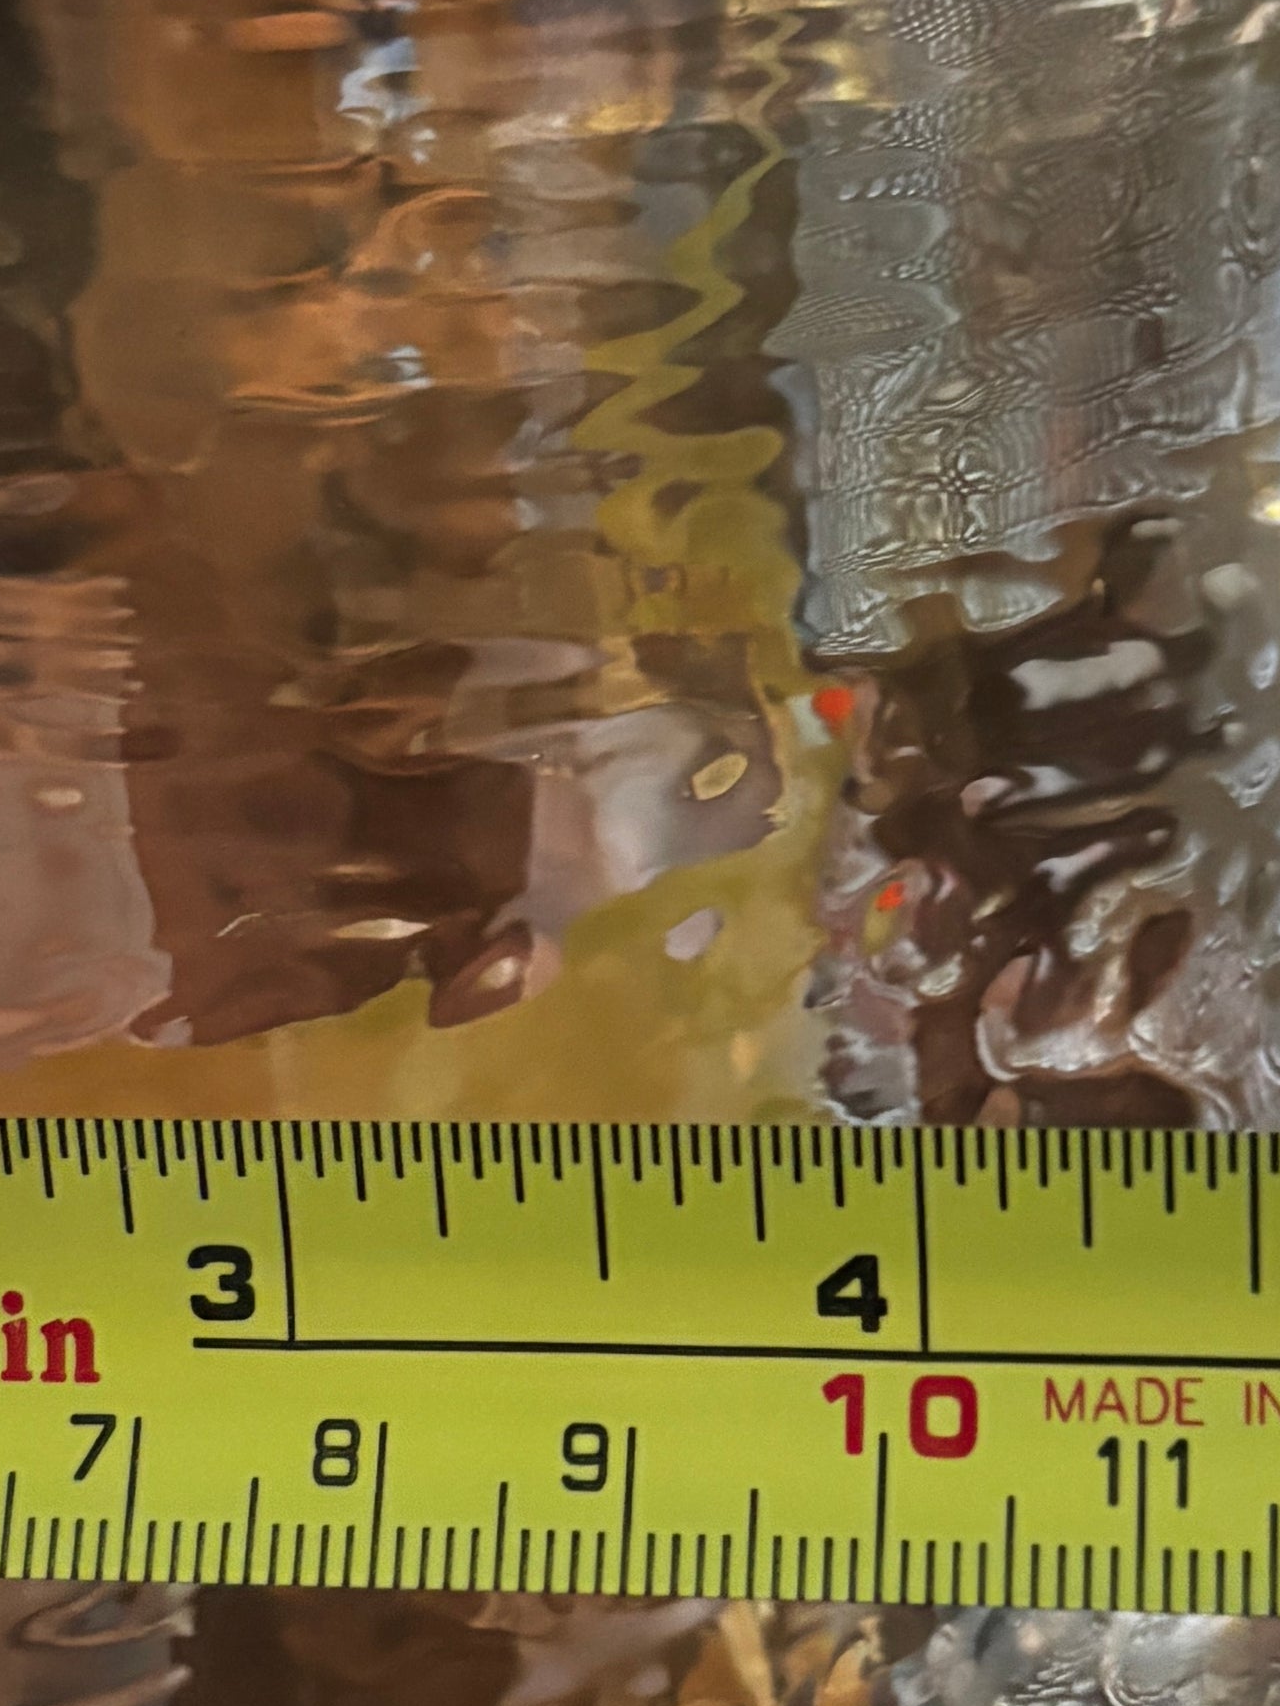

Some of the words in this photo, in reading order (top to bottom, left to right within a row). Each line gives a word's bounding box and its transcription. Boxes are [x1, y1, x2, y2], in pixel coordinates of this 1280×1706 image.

[187, 1245, 255, 1321] 3
[816, 1254, 888, 1333] 4
[821, 1374, 979, 1460] 10
[1044, 1376, 1206, 1426] MADE
[68, 1413, 116, 1481] 7
[312, 1419, 360, 1487] 8
[560, 1423, 608, 1492] 9
[1098, 1437, 1189, 1509] 11
